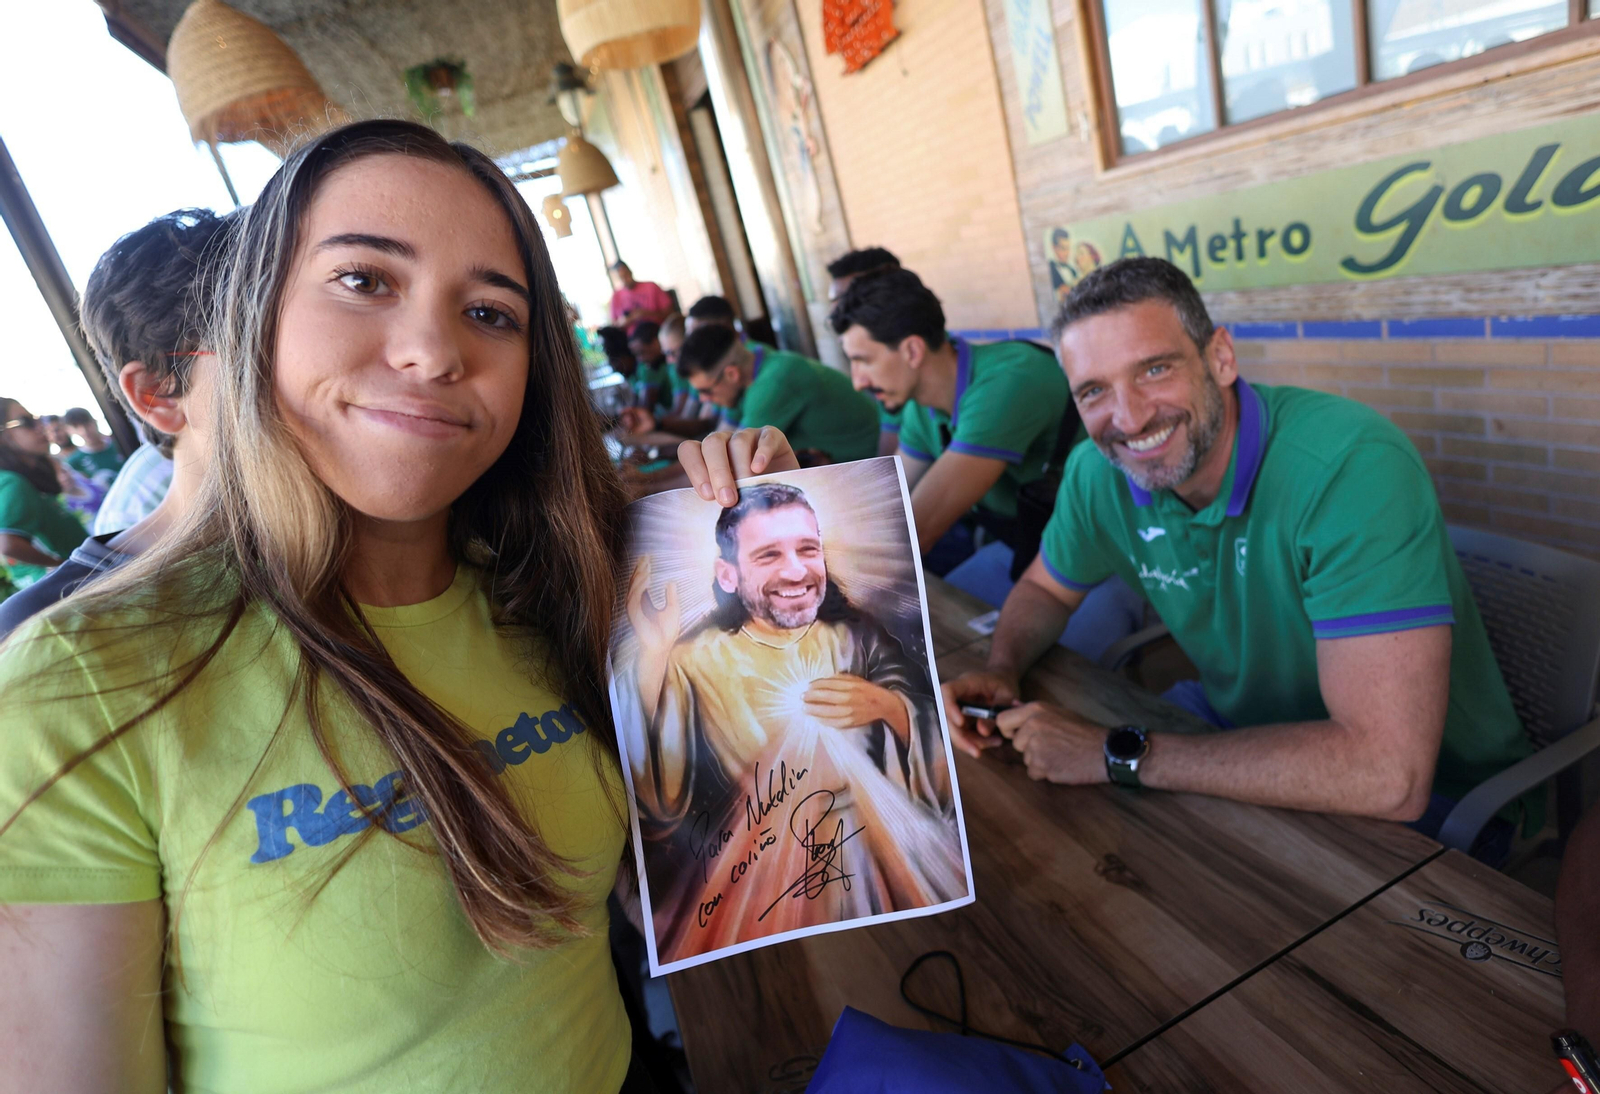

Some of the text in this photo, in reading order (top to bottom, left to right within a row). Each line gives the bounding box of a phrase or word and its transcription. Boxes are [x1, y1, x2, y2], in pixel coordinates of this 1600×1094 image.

[1120, 222, 1146, 259] A
[1164, 217, 1312, 278] Metro
[698, 892, 723, 928] con
[1410, 908, 1562, 973] chweppes
